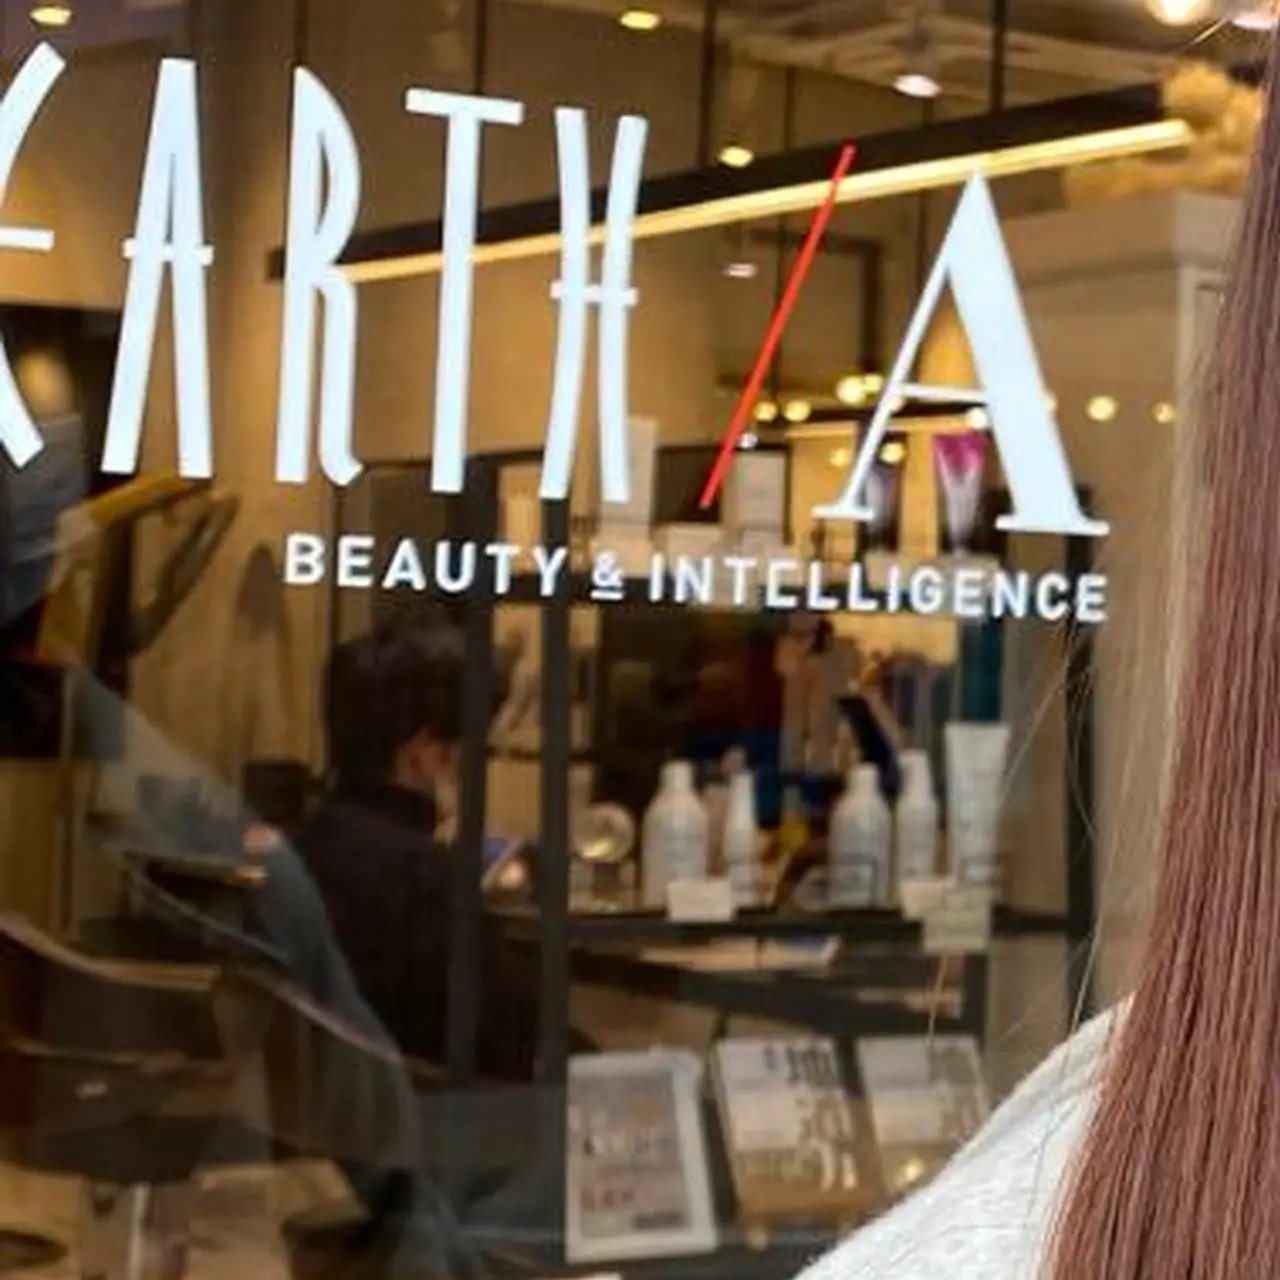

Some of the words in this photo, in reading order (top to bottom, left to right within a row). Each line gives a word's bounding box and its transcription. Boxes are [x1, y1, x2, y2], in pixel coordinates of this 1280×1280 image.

[285, 533, 567, 596] BEAUTY
[591, 549, 626, 600] &
[648, 553, 1107, 623] INTELLIGENCE
